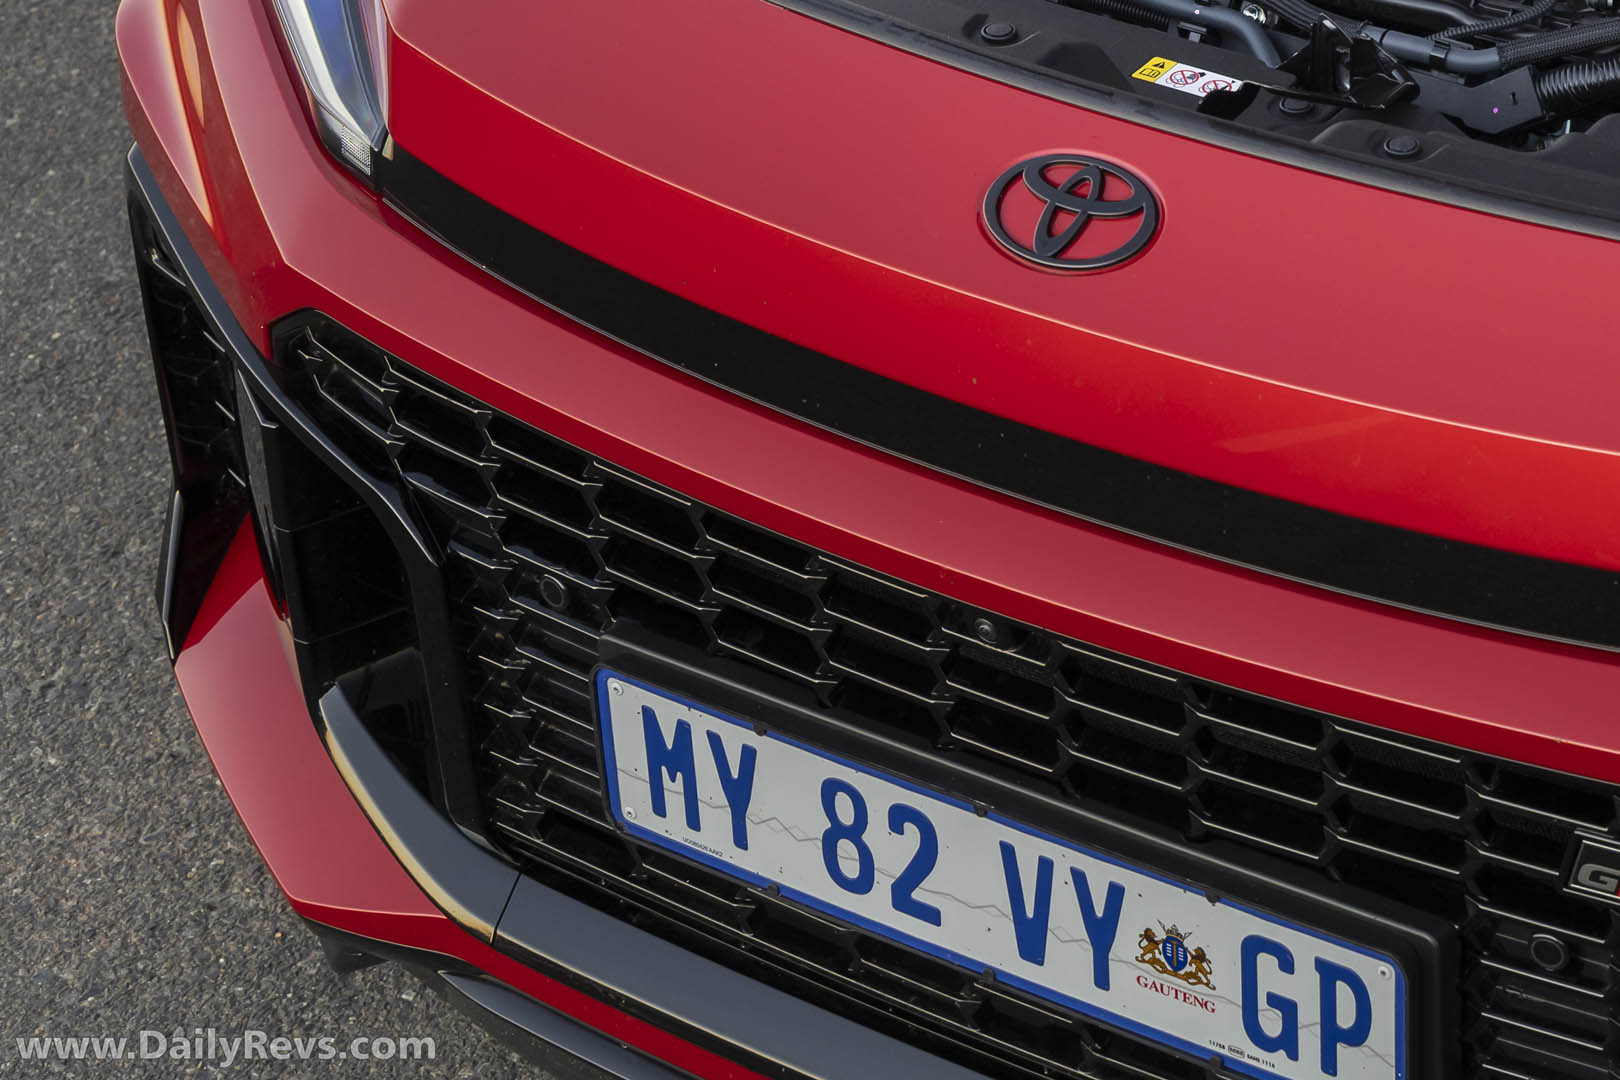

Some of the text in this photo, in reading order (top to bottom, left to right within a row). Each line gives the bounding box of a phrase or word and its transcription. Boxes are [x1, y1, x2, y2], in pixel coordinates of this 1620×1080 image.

[641, 704, 1373, 1077] MY 82 VY GP
[1136, 975, 1216, 1013] GAUTENG
